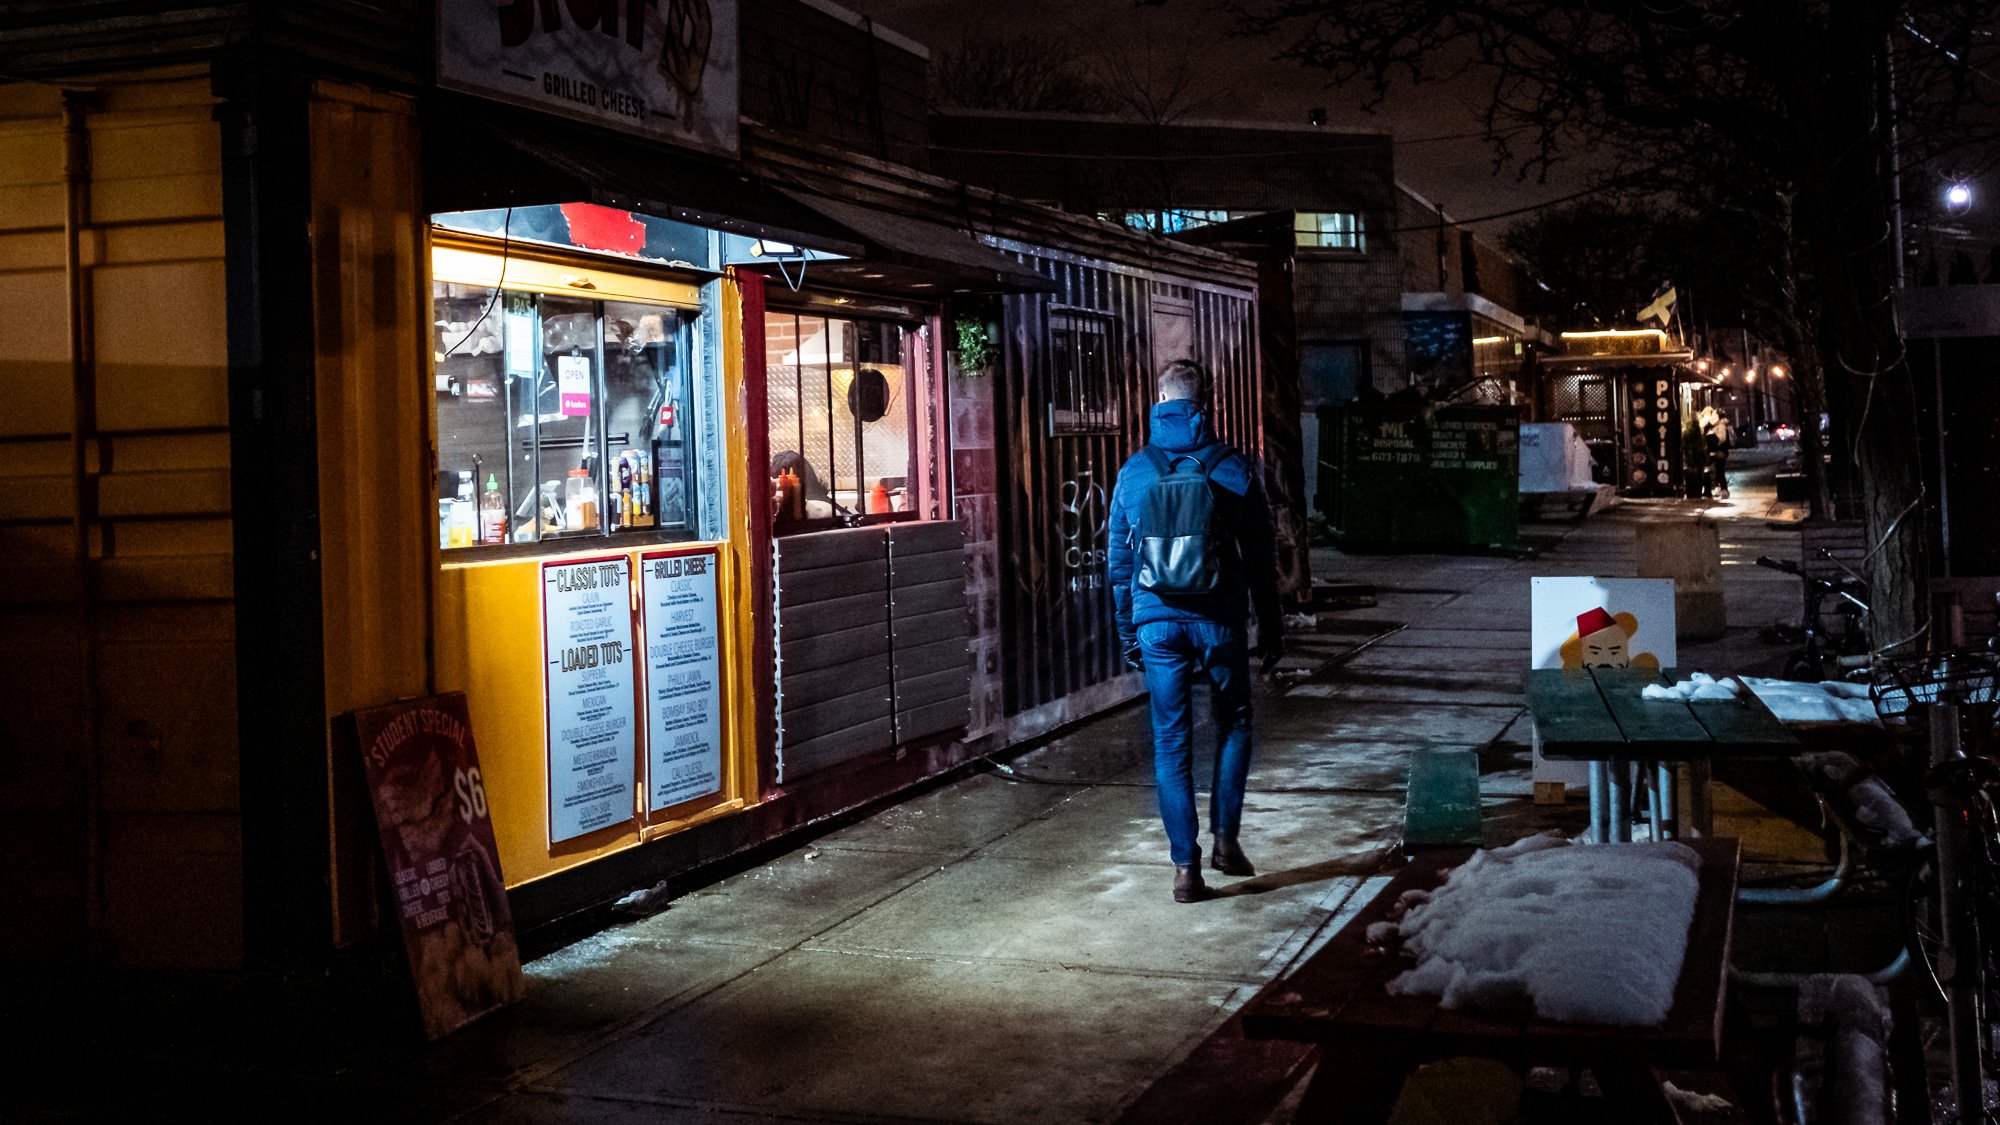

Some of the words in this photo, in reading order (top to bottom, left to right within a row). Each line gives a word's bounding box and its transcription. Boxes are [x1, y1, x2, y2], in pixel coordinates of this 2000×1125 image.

[543, 72, 596, 106] GRILLED
[601, 88, 646, 120] CHEESE
[565, 369, 584, 380] OPEN
[1374, 438, 1415, 449] DISPOSAL
[655, 559, 681, 578] GRILLED
[684, 557, 706, 575] CHEESE
[556, 566, 597, 591] CLASSIC
[599, 564, 619, 586] TOTS
[671, 579, 691, 591] CLASSIC
[582, 591, 599, 603] CAJUN
[570, 619, 592, 631] ROASTED
[595, 616, 612, 627] GARLIC
[671, 609, 693, 622] HARVEST
[650, 643, 671, 657] DOUBLE
[674, 640, 693, 653] CHEESE
[695, 636, 714, 649] BURGER
[561, 644, 598, 672] LOADED
[601, 640, 622, 665] TOTS
[582, 667, 606, 681] SUPREME
[668, 672, 685, 685] PHILLY
[583, 694, 605, 708] MEXICAN
[662, 703, 684, 719] BOMBAY
[686, 700, 696, 713] BAD
[698, 698, 707, 710] BOY
[562, 726, 583, 740] DOUBLE
[585, 721, 604, 735] CHEESE
[606, 716, 625, 730] BURGER
[371, 710, 419, 769] STUDENT
[418, 708, 466, 749] SPECIAL
[573, 746, 616, 765] MEDITERRANEAN
[684, 760, 702, 776] QUESO
[577, 773, 613, 791] SMOKEHOUSE
[454, 766, 487, 825] $6
[580, 804, 597, 818] SOUTH
